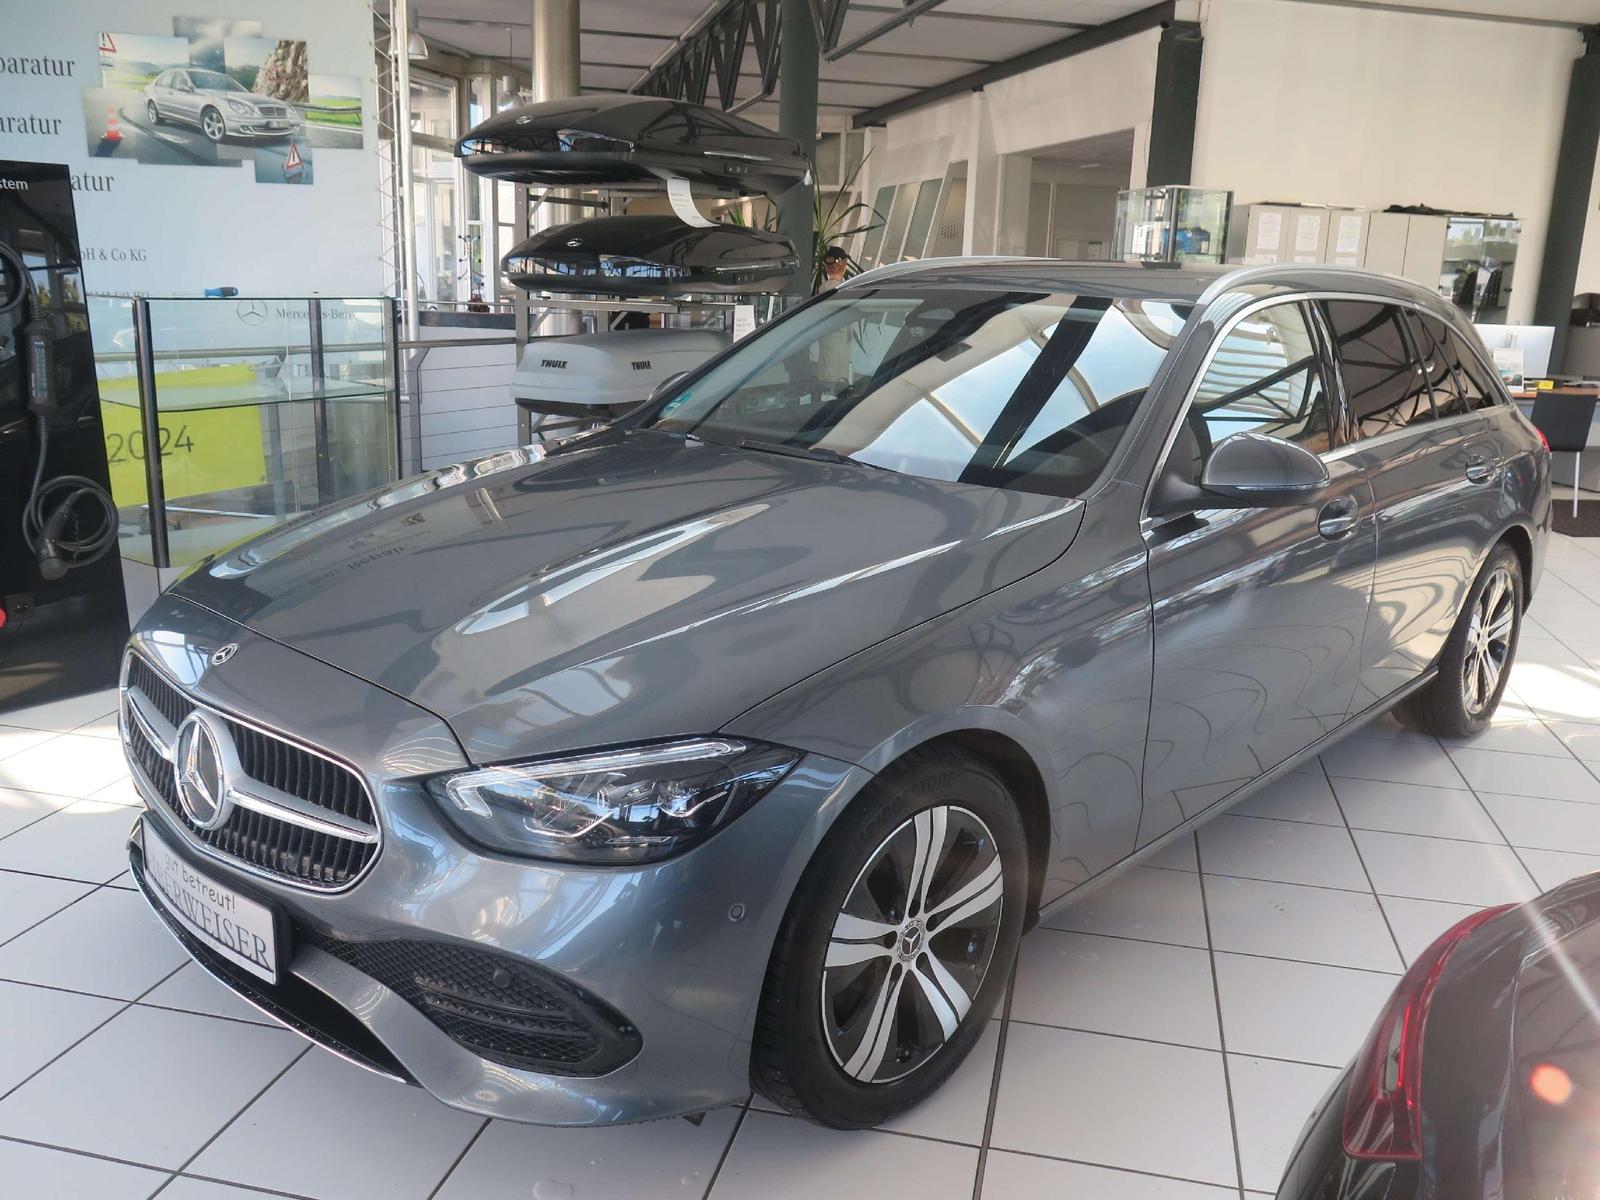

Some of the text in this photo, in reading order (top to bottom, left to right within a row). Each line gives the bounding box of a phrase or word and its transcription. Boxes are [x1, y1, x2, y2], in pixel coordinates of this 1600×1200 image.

[98, 247, 108, 261] &
[111, 247, 127, 261] Co
[129, 248, 147, 262] KG
[540, 359, 568, 369] THULE
[631, 360, 652, 370] THULE
[106, 424, 194, 463] 2024
[181, 862, 236, 915] betreut!
